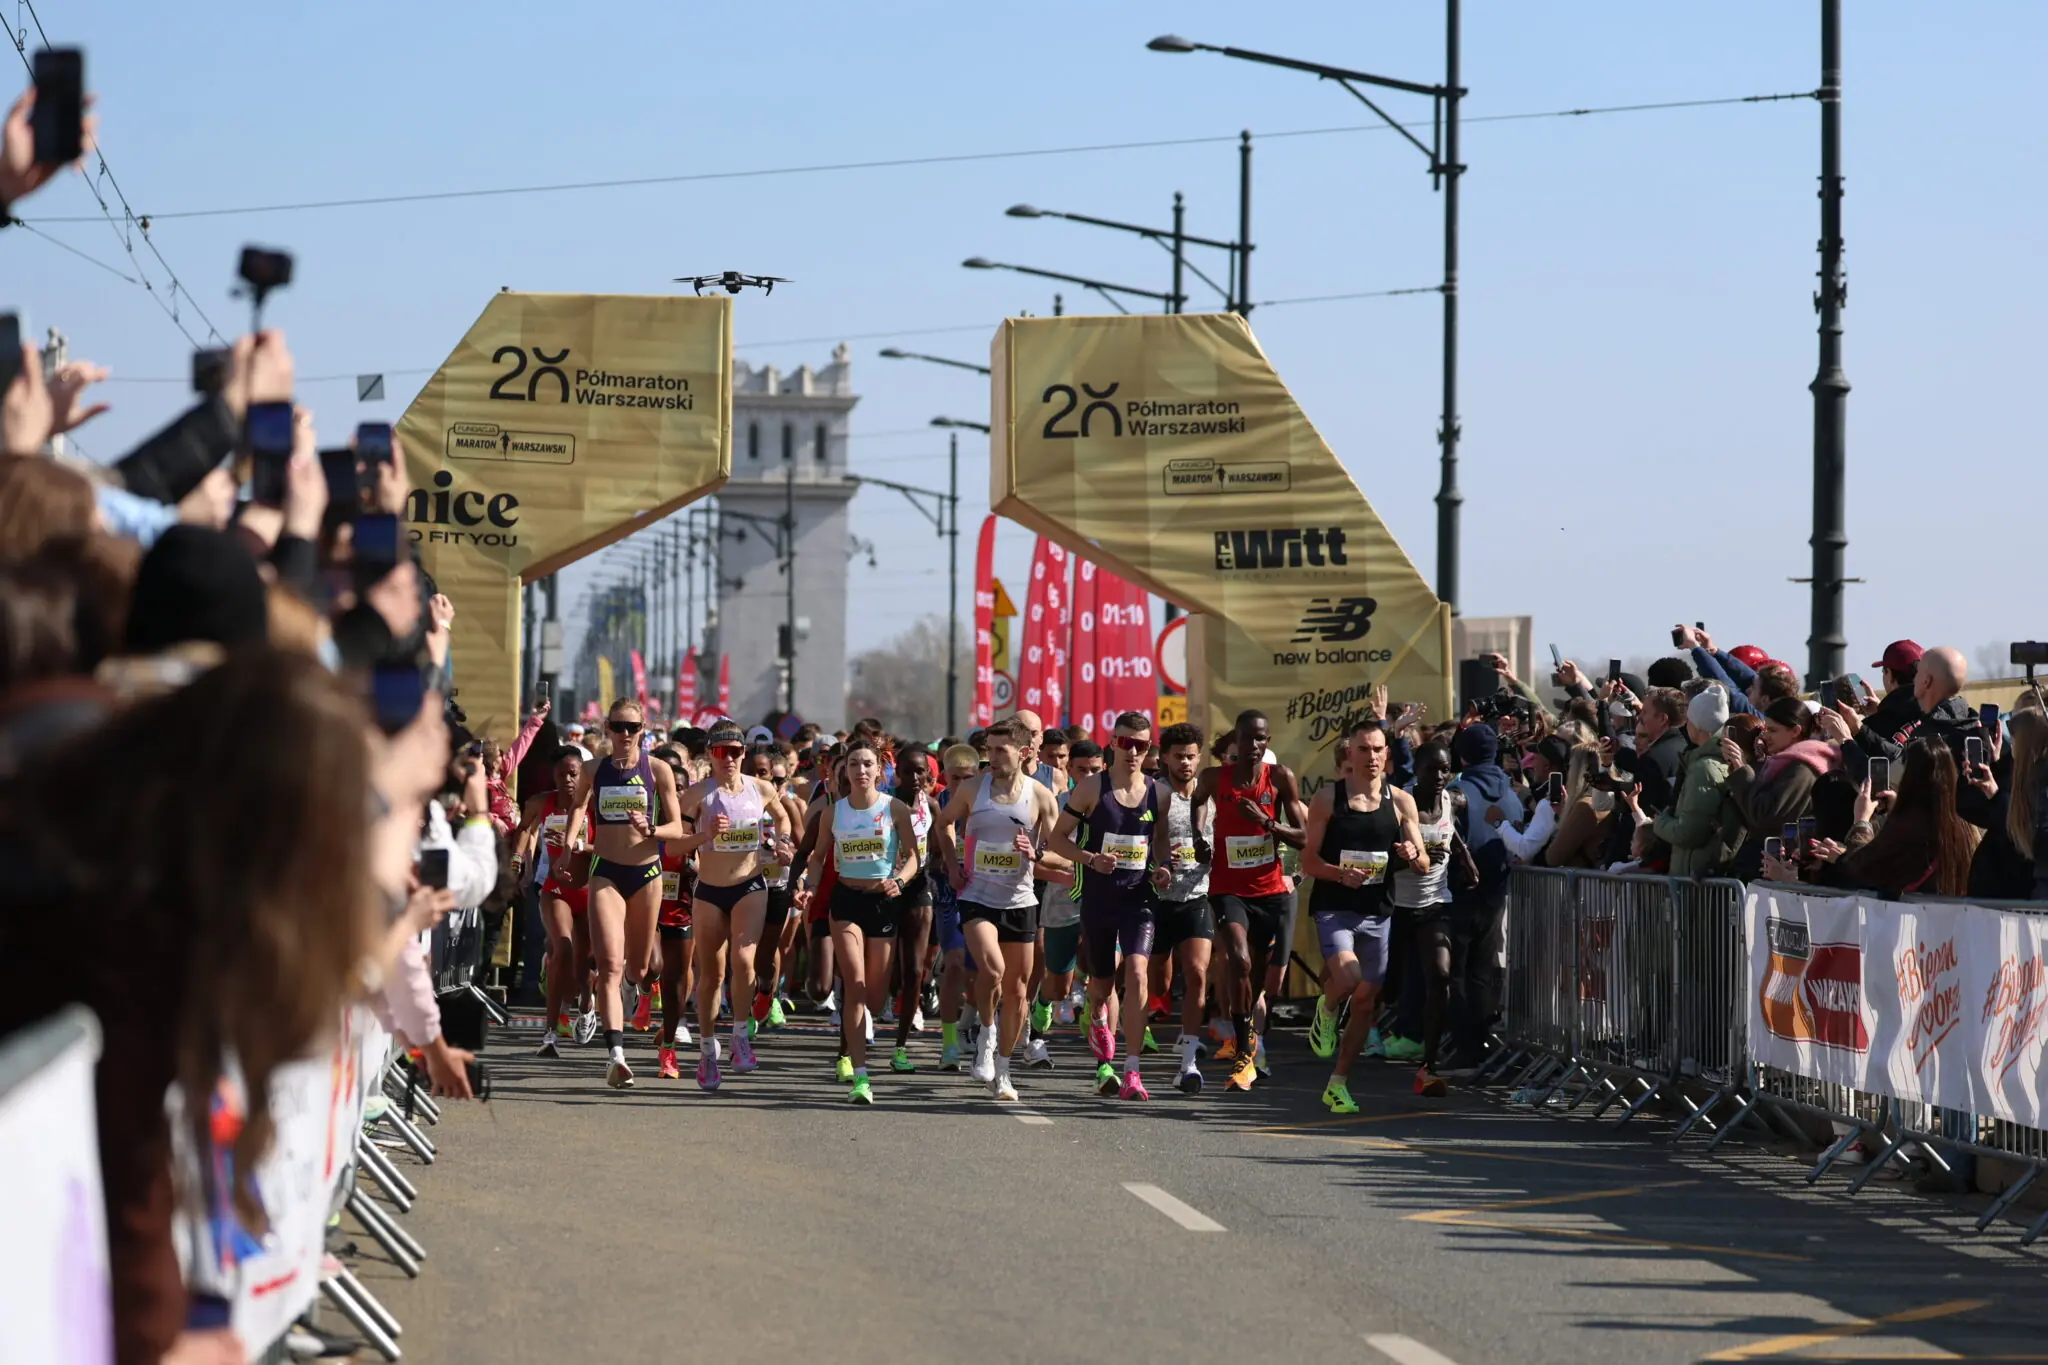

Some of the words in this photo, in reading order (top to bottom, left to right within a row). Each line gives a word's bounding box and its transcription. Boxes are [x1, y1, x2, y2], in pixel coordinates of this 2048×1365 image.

[576, 369, 689, 391] Półmaraton
[576, 389, 693, 410] Warszawski
[1127, 400, 1239, 417] Półmaraton
[1128, 417, 1246, 436] Warszawski
[456, 438, 497, 449] MARATON
[511, 442, 567, 454] WARSZAWSKI
[1172, 474, 1213, 484] MARATON
[1228, 472, 1283, 483] WARSZAWSKI
[429, 531, 465, 543] FIT
[469, 533, 517, 547] YOU
[1230, 527, 1348, 569] Witt
[1273, 651, 1311, 666] new
[1315, 648, 1392, 664] balance
[1101, 656, 1152, 678] 01:10
[1287, 682, 1372, 723] #Biegam
[601, 799, 645, 811] Jarząbek
[720, 831, 753, 842] Glinka
[842, 840, 883, 853] Birdaha
[1237, 847, 1265, 859] M125
[984, 854, 1013, 866] M129
